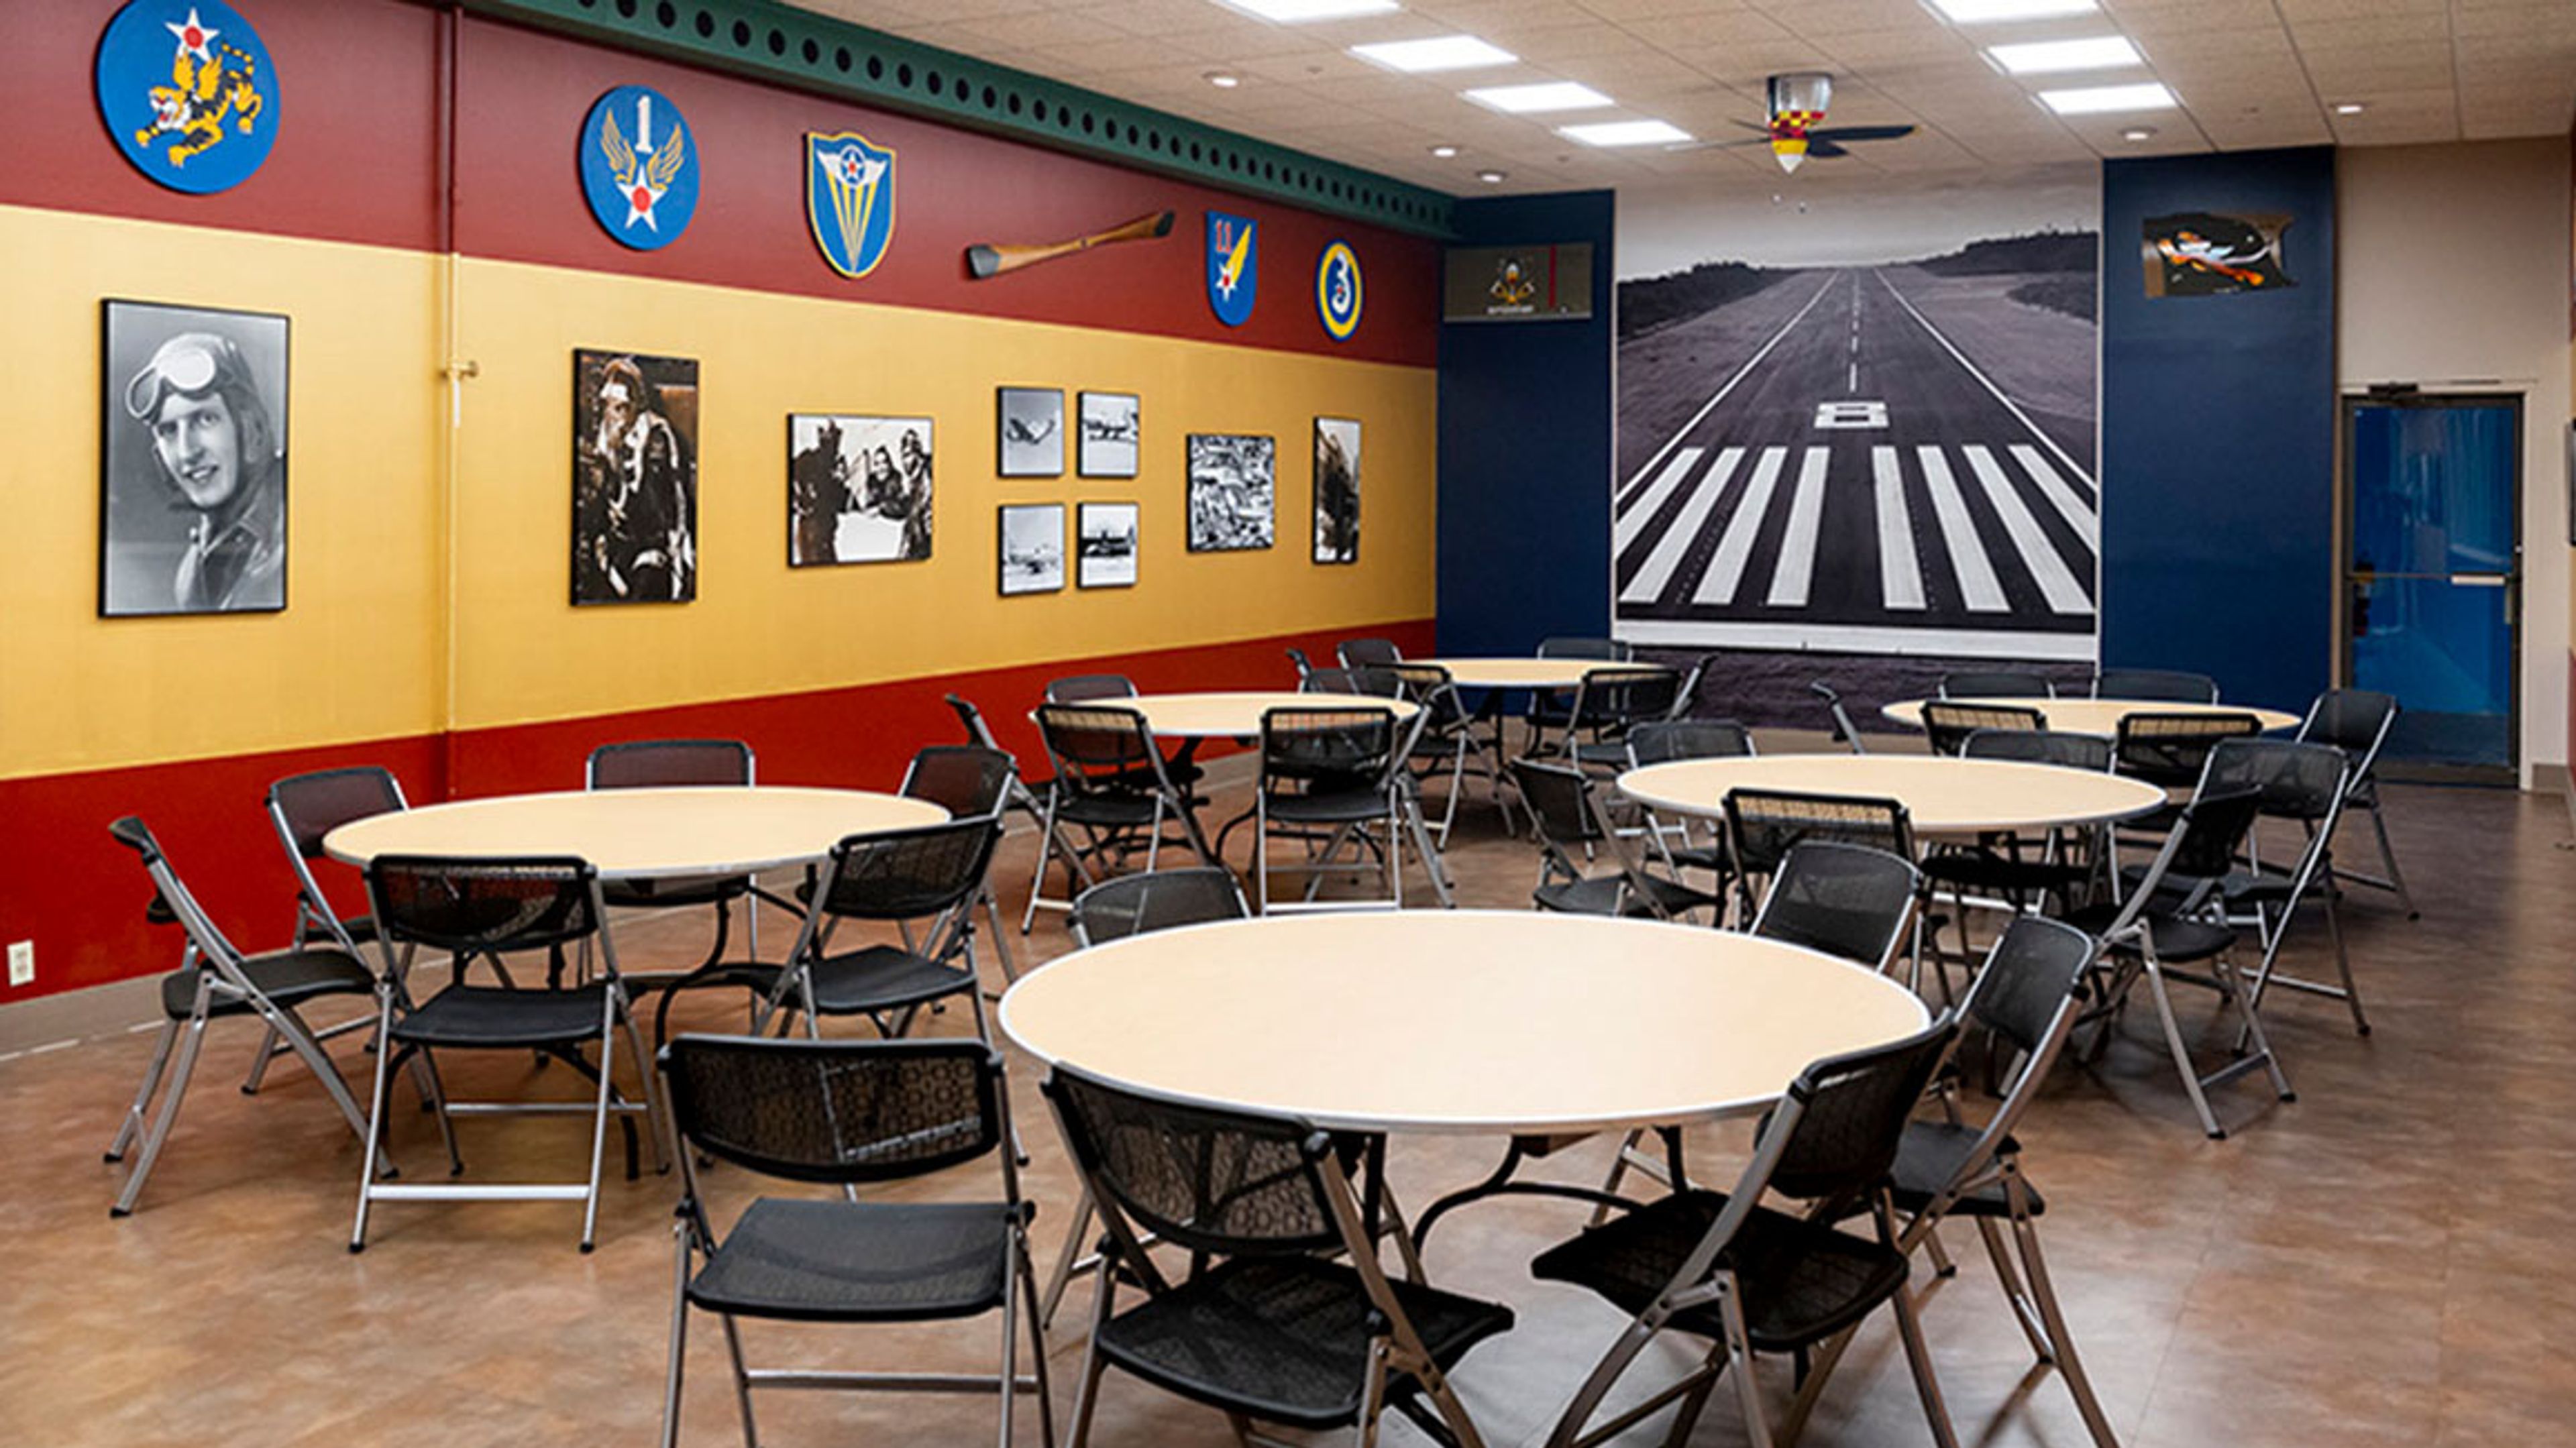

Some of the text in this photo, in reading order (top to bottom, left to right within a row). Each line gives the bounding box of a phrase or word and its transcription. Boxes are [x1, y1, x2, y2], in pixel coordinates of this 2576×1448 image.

[635, 94, 653, 154] 1
[1332, 250, 1351, 315] 3
[1814, 401, 1889, 429] 8
